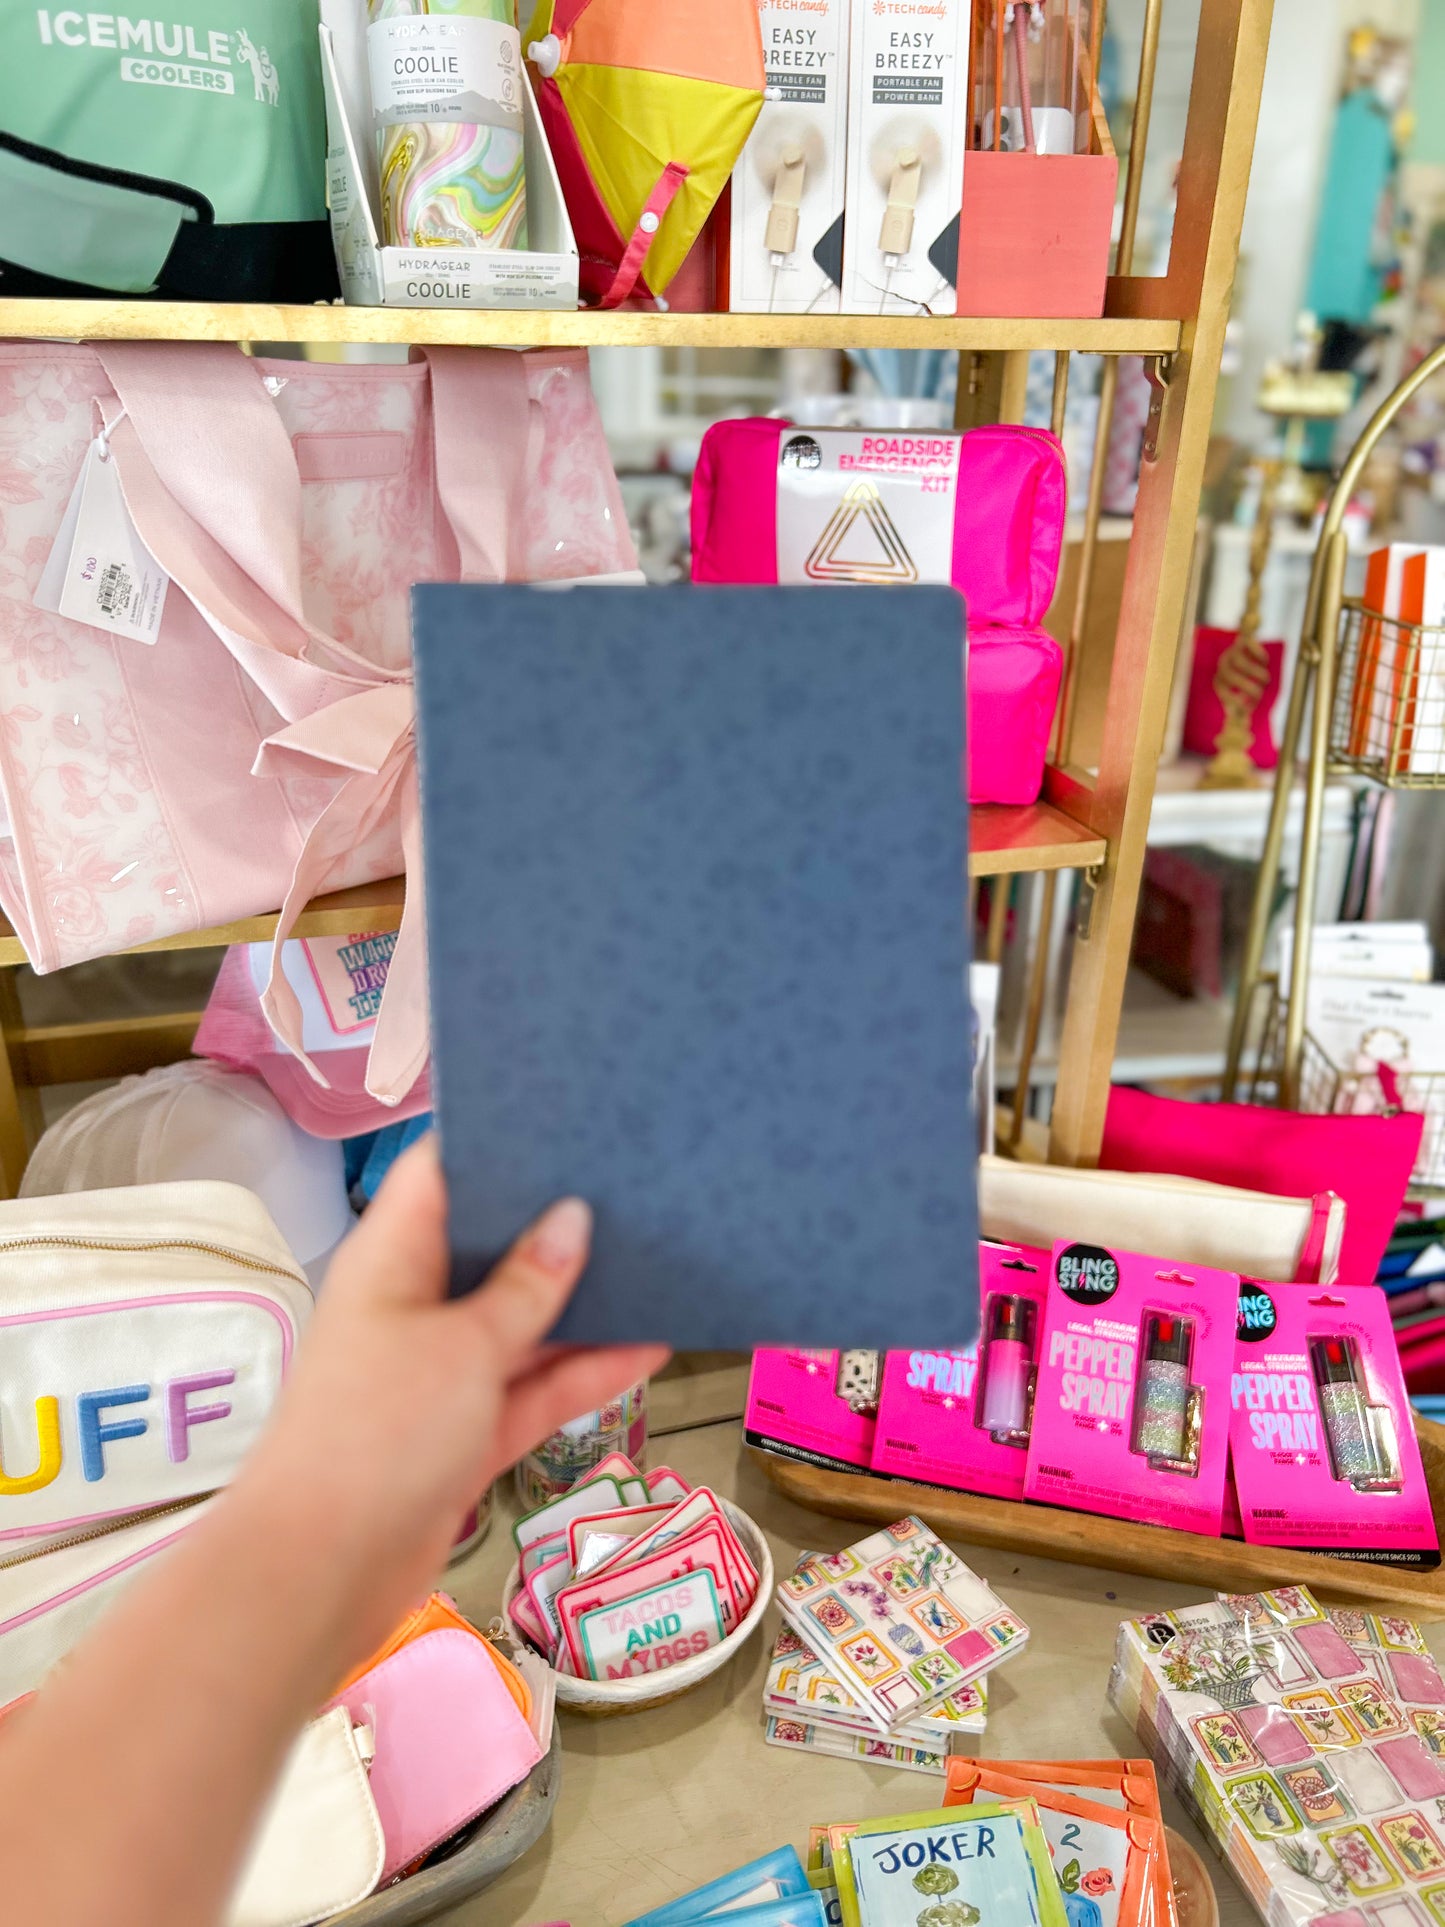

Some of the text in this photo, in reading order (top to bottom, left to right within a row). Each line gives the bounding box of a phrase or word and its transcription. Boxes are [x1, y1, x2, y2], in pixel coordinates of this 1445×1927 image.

[769, 0, 798, 10] TECH
[887, 3, 916, 14] TECH
[37, 9, 232, 66] ICEMULE
[772, 28, 817, 45] EASY
[890, 32, 934, 48] EASY
[394, 56, 459, 75] COOLIE
[876, 53, 945, 69] BREEZY
[129, 62, 228, 90] COOLERS
[766, 74, 823, 85] ORTABLE FAN
[877, 78, 940, 87] PORTABLE FAN
[801, 91, 824, 101] BANK
[884, 92, 915, 102] POWER
[917, 93, 940, 102] BANK
[399, 259, 471, 271] HYDRAGEAR
[407, 281, 471, 299] COOLIE
[862, 437, 956, 456] ROADSIDE
[921, 475, 952, 493] KIT
[1059, 1256, 1117, 1275] BLING
[1237, 1294, 1272, 1312] ING
[1048, 1330, 1135, 1381] PEPPER
[905, 1350, 977, 1398] SPRAY
[1059, 1371, 1132, 1420] SPRAY
[1230, 1372, 1315, 1411] PEPPER
[1249, 1411, 1318, 1450] SPRAY
[602, 1586, 694, 1635] TACOS
[626, 1613, 682, 1652] AND
[1060, 1823, 1083, 1851] 2
[872, 1827, 996, 1874] JOKER
